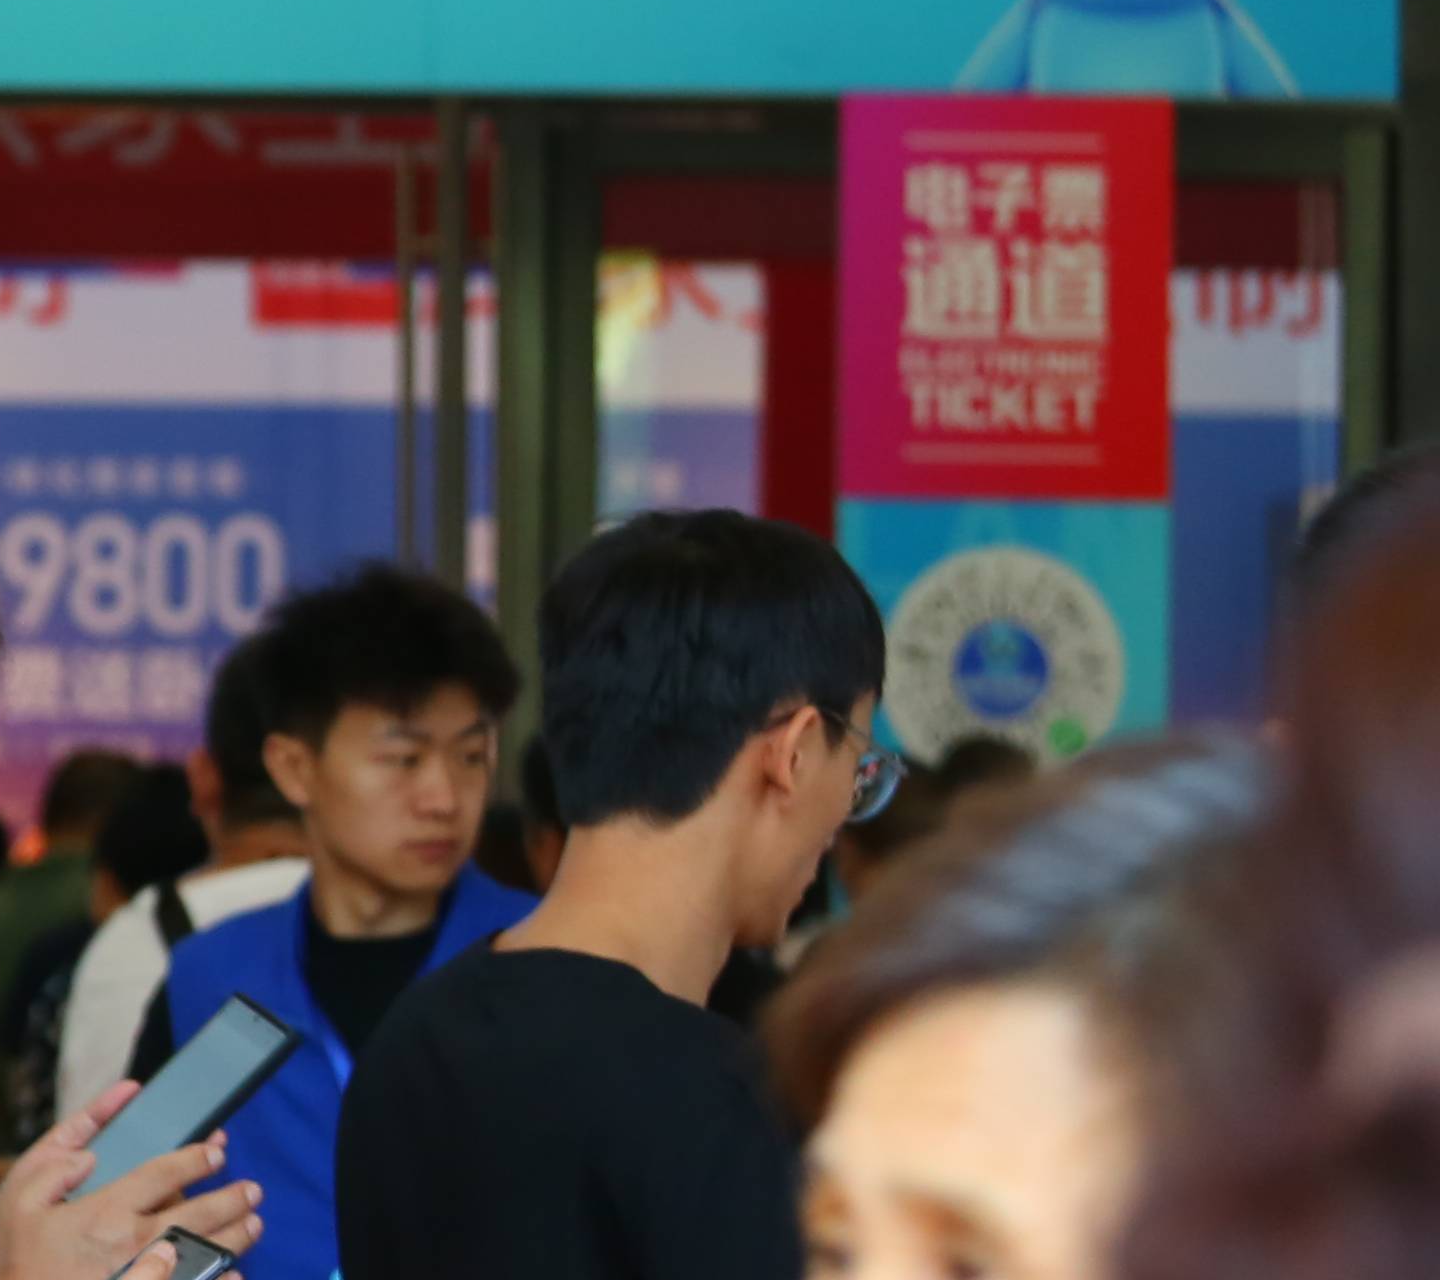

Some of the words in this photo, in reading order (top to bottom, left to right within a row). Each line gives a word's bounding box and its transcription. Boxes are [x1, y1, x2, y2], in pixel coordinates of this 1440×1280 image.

[904, 163, 1106, 233] 电子票
[902, 235, 1108, 341] 通道
[907, 379, 1099, 430] TICKET
